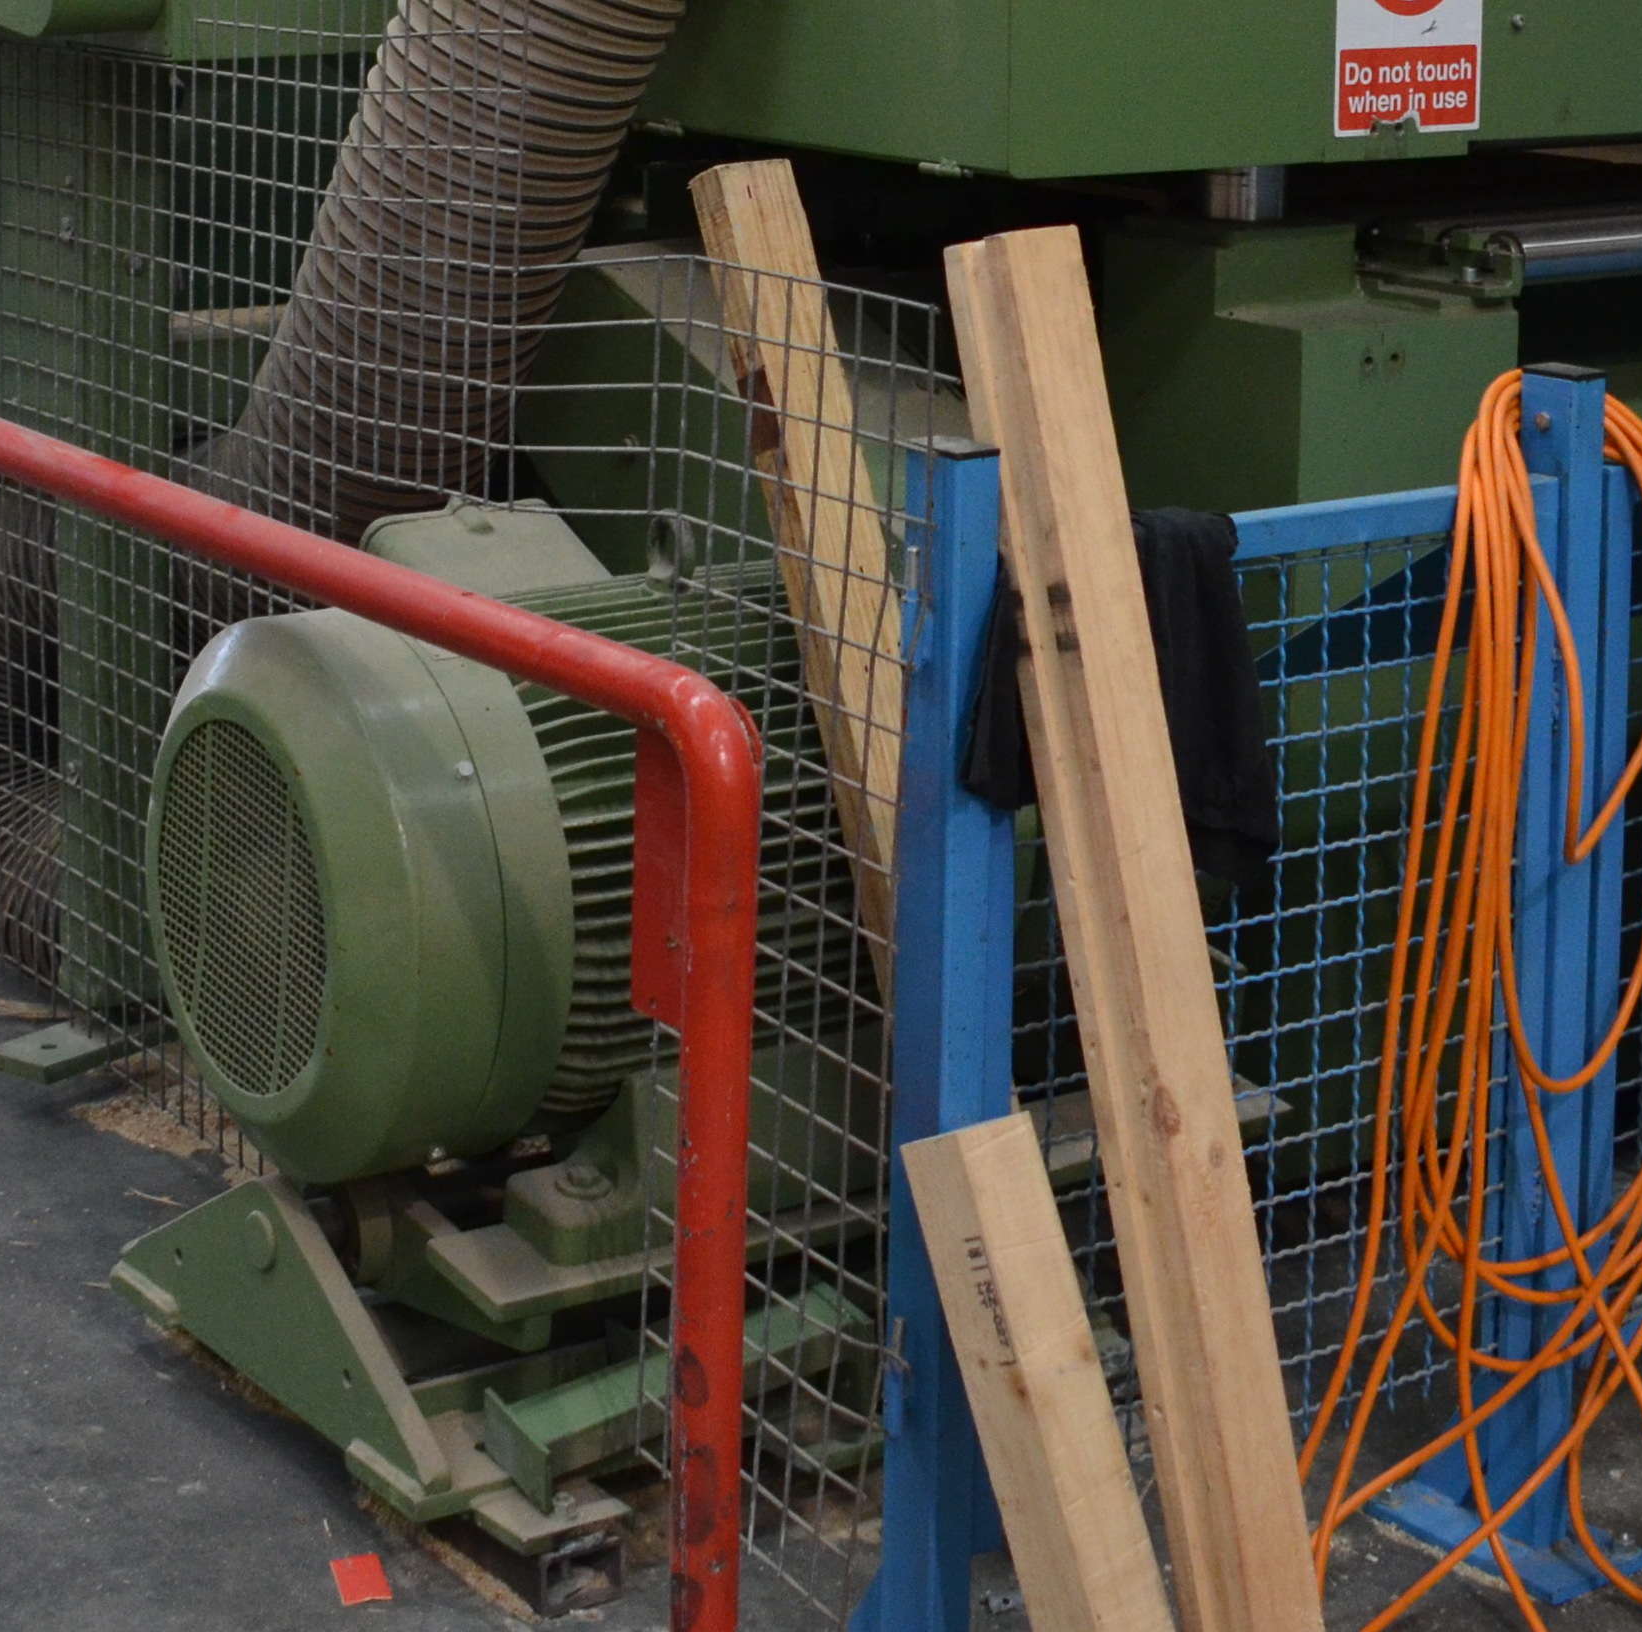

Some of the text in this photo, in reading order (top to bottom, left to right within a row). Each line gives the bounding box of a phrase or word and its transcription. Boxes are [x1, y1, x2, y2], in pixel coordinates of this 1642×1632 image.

[1345, 58, 1472, 85] Do not touch
[1348, 88, 1468, 113] when in use
